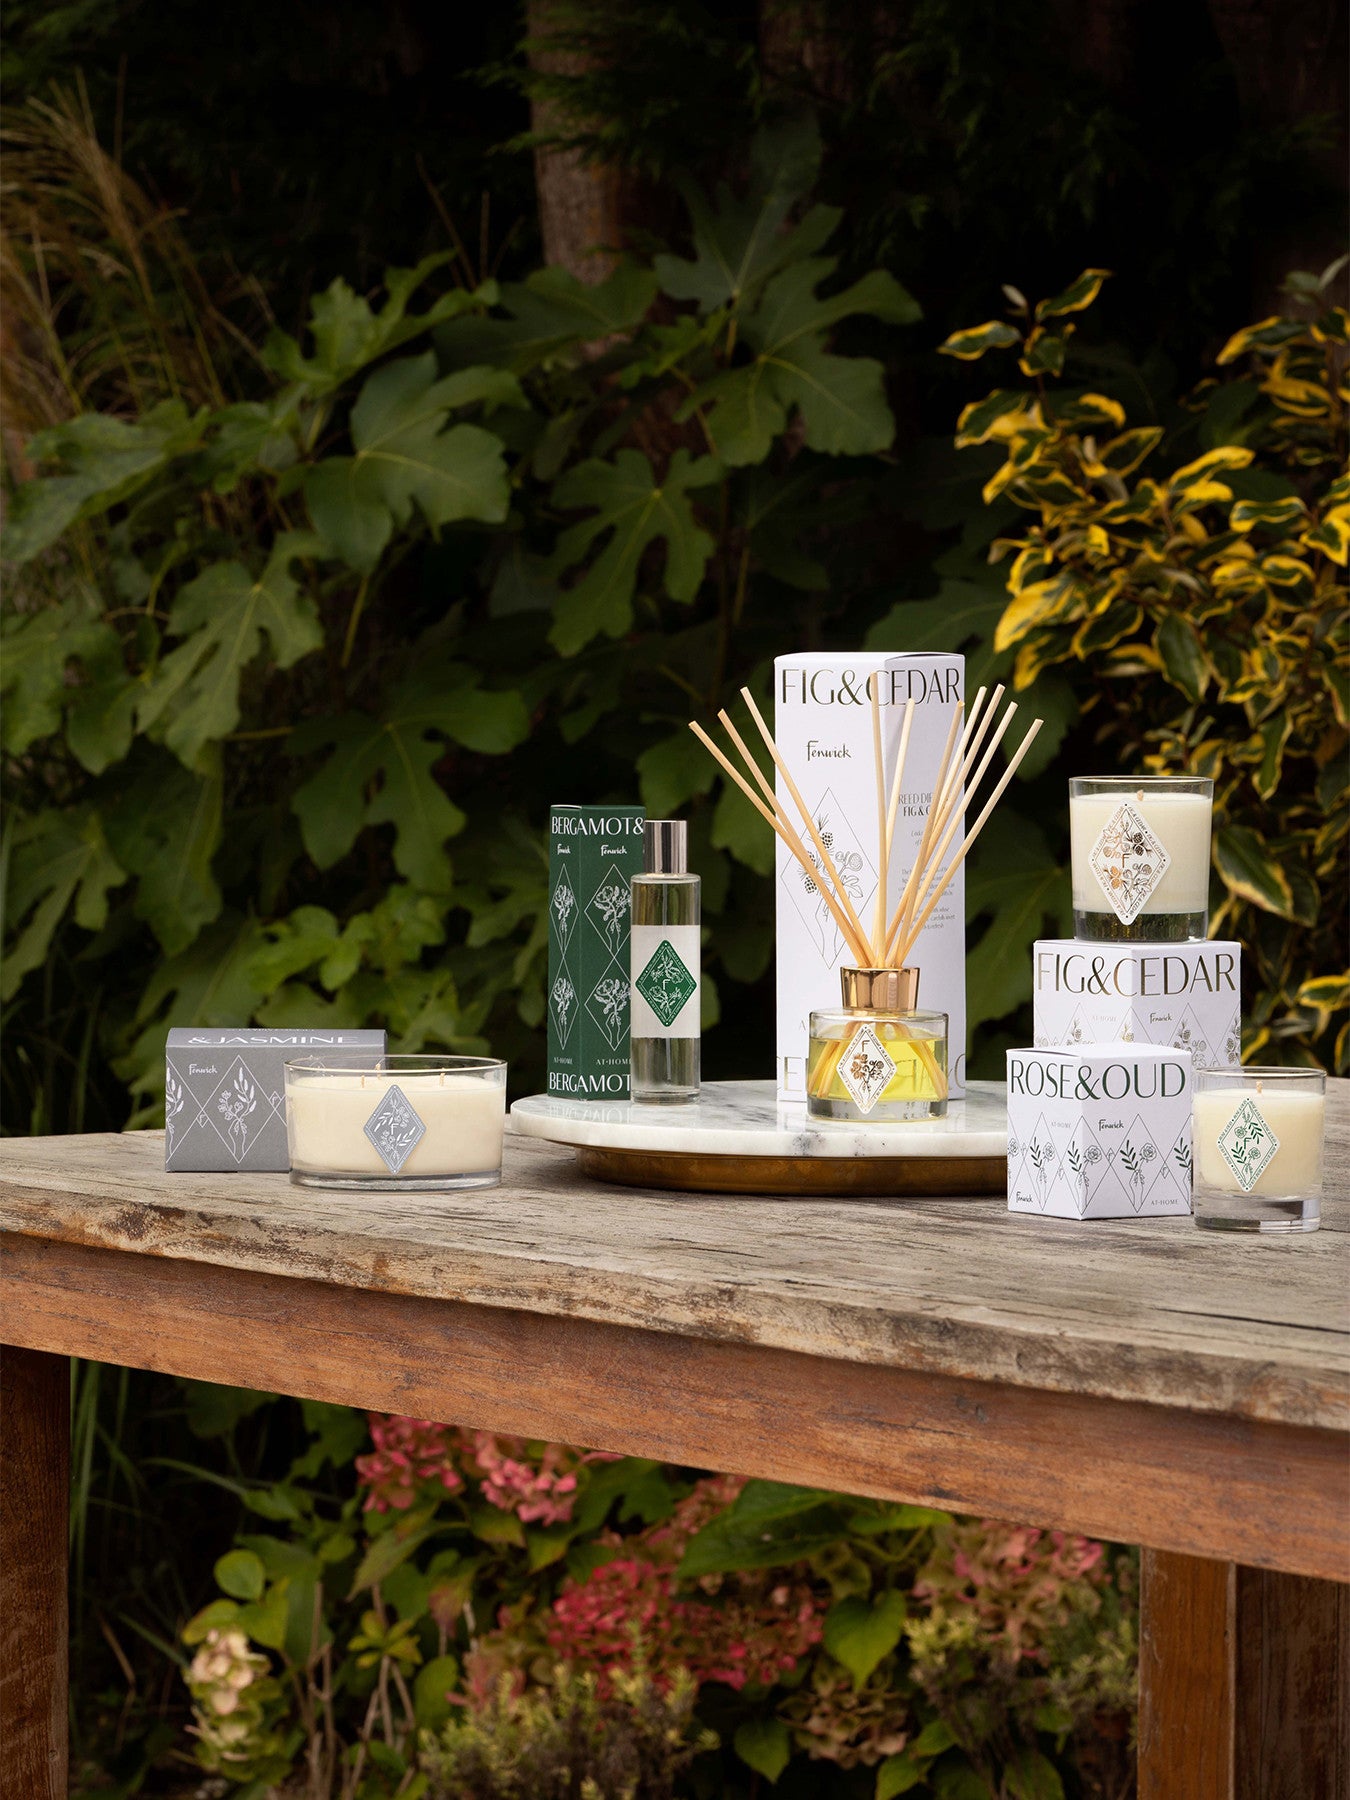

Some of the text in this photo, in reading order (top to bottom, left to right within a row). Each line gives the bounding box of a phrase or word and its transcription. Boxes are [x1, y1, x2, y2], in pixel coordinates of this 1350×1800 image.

[782, 668, 960, 706] FIG&CEDAR
[806, 740, 852, 761] Fenwick
[551, 816, 645, 835] BERGAMOT&
[600, 844, 628, 857] Fenwick
[1037, 953, 1236, 997] FIG&CEDAR
[1149, 1012, 1173, 1024] Fenwick
[188, 1063, 218, 1075] Fenwick
[1011, 1059, 1186, 1101] ROSE&OUD
[1098, 1119, 1124, 1131] Fenwick
